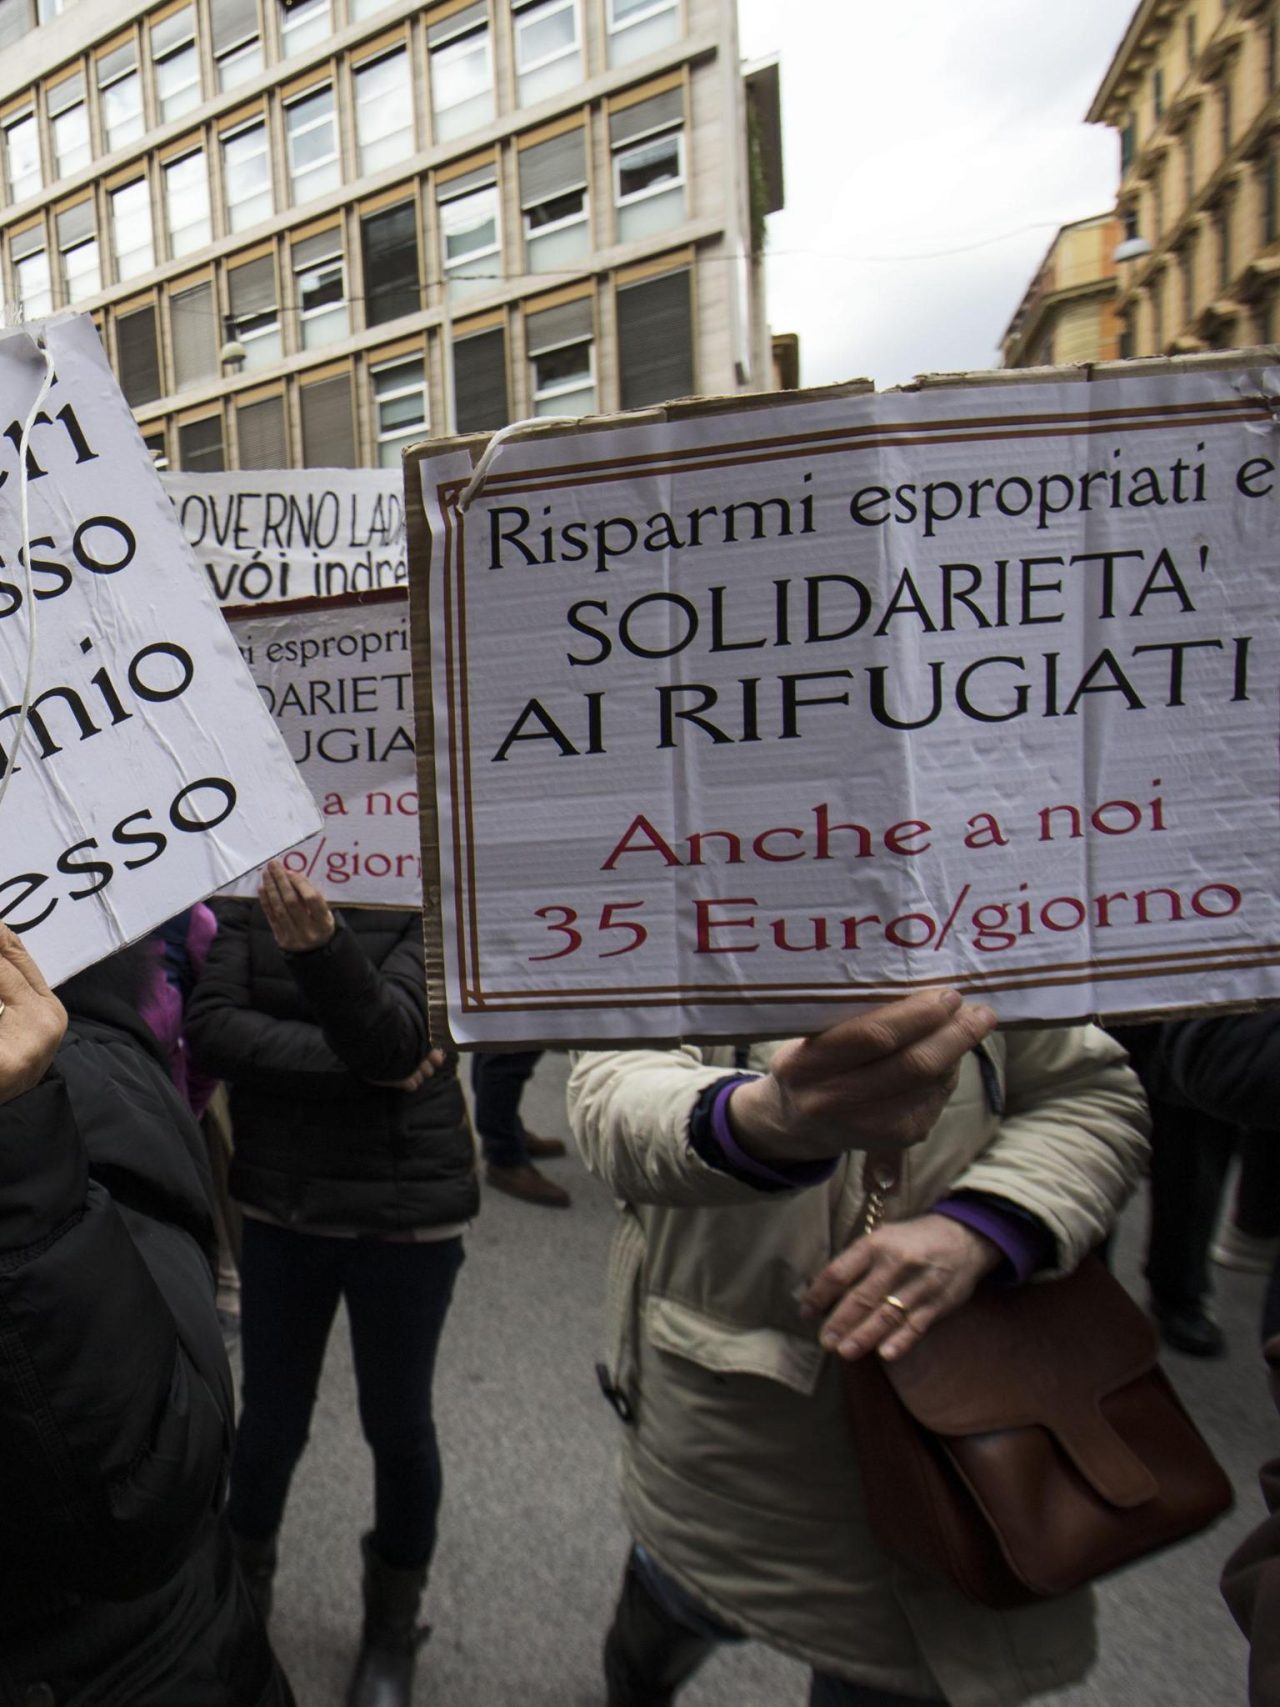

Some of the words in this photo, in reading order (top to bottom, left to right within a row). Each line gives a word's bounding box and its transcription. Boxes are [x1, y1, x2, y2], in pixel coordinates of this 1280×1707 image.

[169, 491, 339, 549] OVERNO
[349, 493, 406, 547] LAD
[487, 472, 817, 574] Risparmi
[849, 441, 1208, 538] espropriati
[1235, 457, 1276, 499] e
[566, 543, 1209, 667] SOLIDARIETA'
[490, 691, 607, 763] AI
[655, 636, 1253, 749] RIFUGIATI
[323, 792, 348, 815] a
[600, 801, 932, 871] Anche
[963, 811, 1008, 850] a
[1037, 777, 1167, 844] noi
[528, 900, 648, 962] 35
[692, 882, 1243, 955] Euro/giorno
